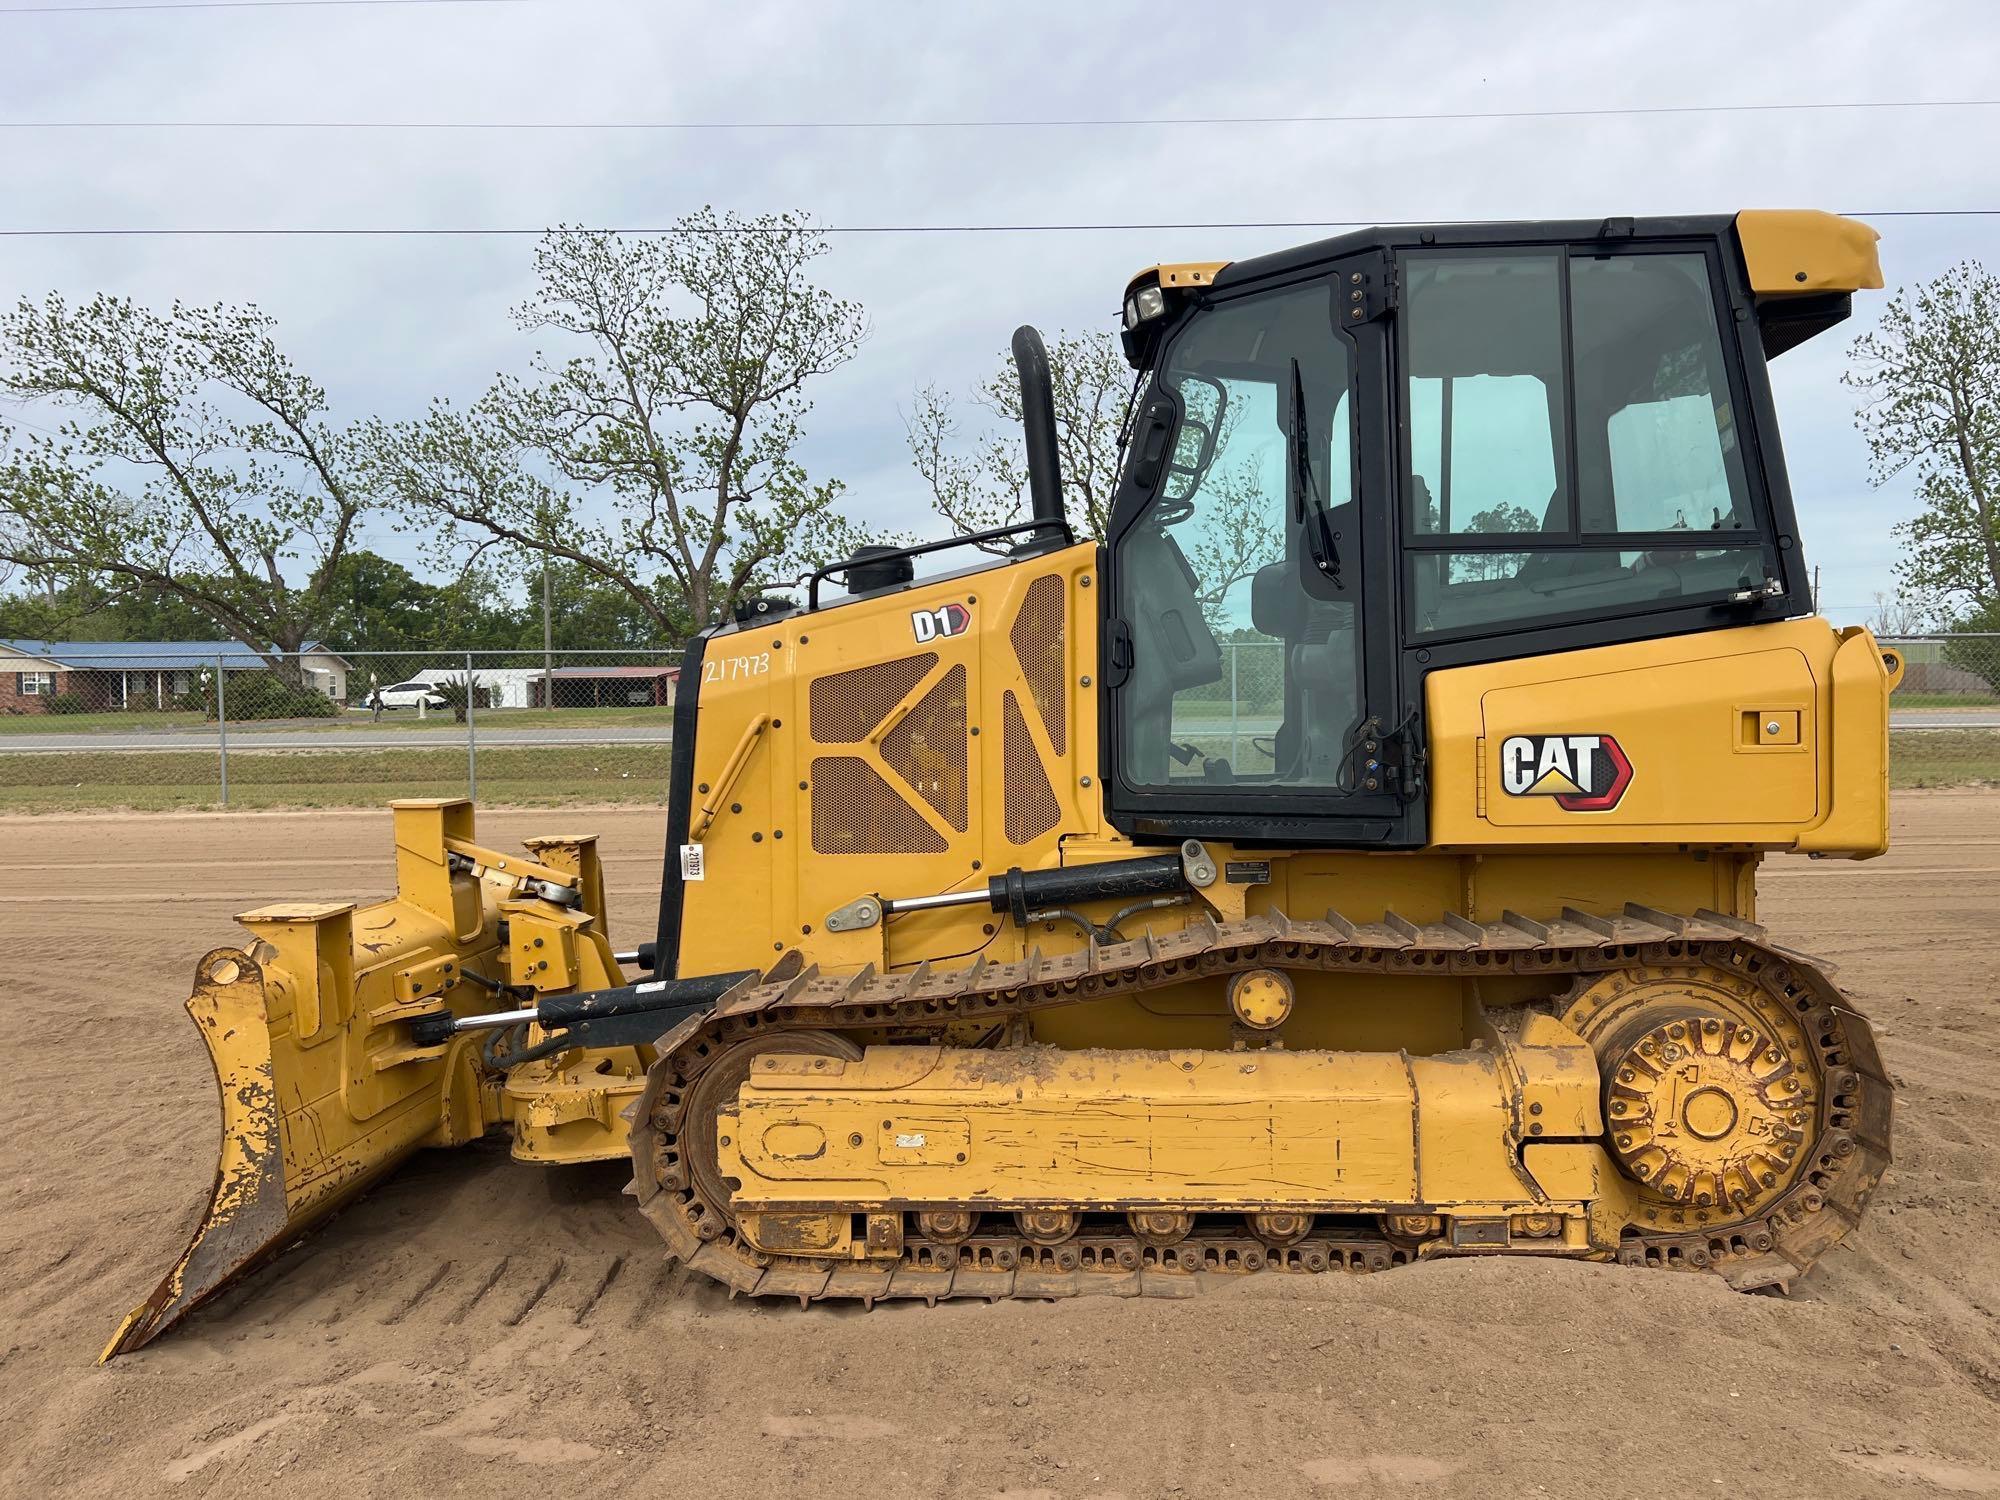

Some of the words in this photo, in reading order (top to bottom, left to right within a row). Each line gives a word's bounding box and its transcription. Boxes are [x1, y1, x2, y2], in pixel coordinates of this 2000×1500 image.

[912, 606, 952, 642] D1
[704, 652, 770, 684] 217973
[1503, 736, 1600, 794] CAT
[689, 852, 700, 876] 217973
